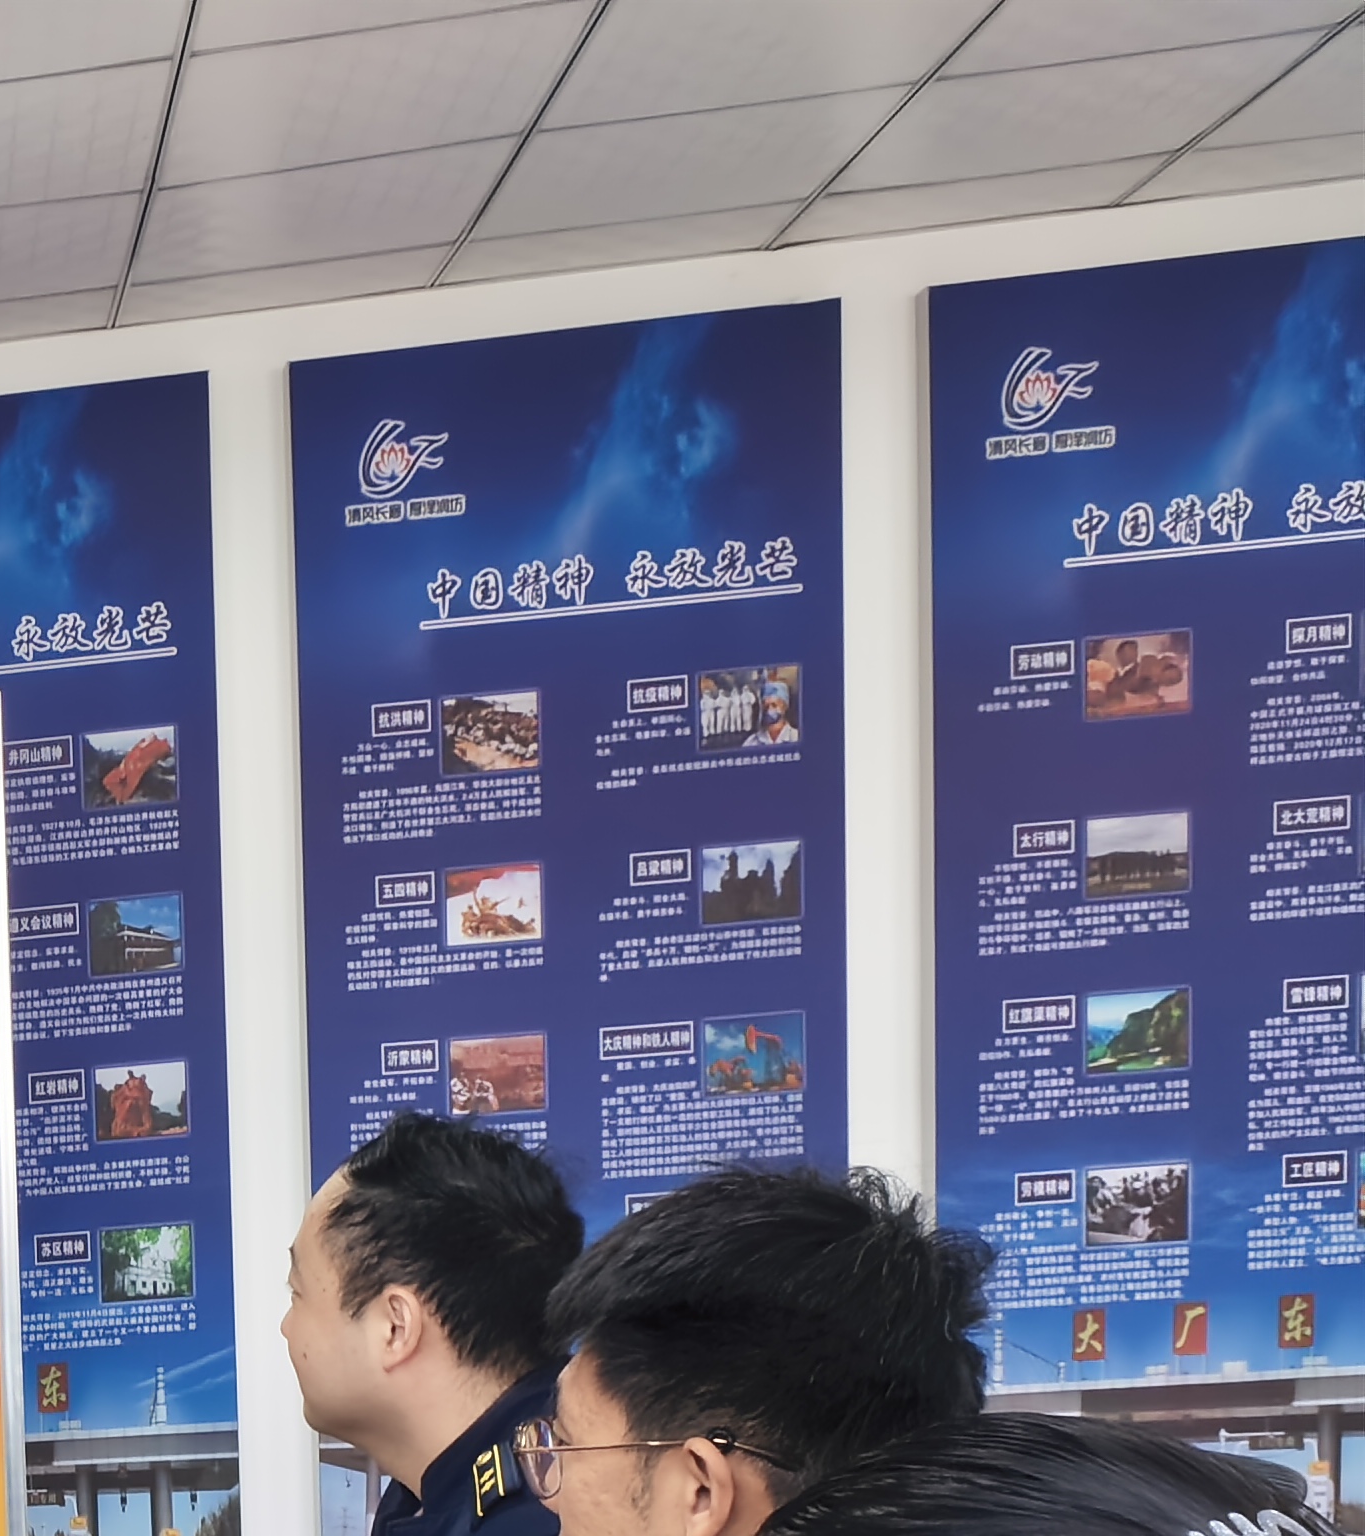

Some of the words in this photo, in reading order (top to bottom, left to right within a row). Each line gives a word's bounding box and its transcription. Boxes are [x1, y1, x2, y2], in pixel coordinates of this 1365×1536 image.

[1073, 488, 1253, 556] 中国精神
[427, 554, 594, 620] 中国精神
[626, 536, 798, 599] 永放光芒
[11, 601, 172, 662] 永放光芒
[1018, 653, 1068, 670] 劳动精神
[633, 684, 682, 705] 抗疫精神
[8, 744, 63, 765] 井冈山精神
[1020, 831, 1069, 849] 太行精神
[35, 1076, 79, 1096] 红岩精神
[40, 1238, 85, 1259] 苏区精神
[1075, 1313, 1103, 1356] 大
[1176, 1305, 1205, 1349] 厂
[1281, 1296, 1311, 1342] 东
[40, 1365, 67, 1408] 东
